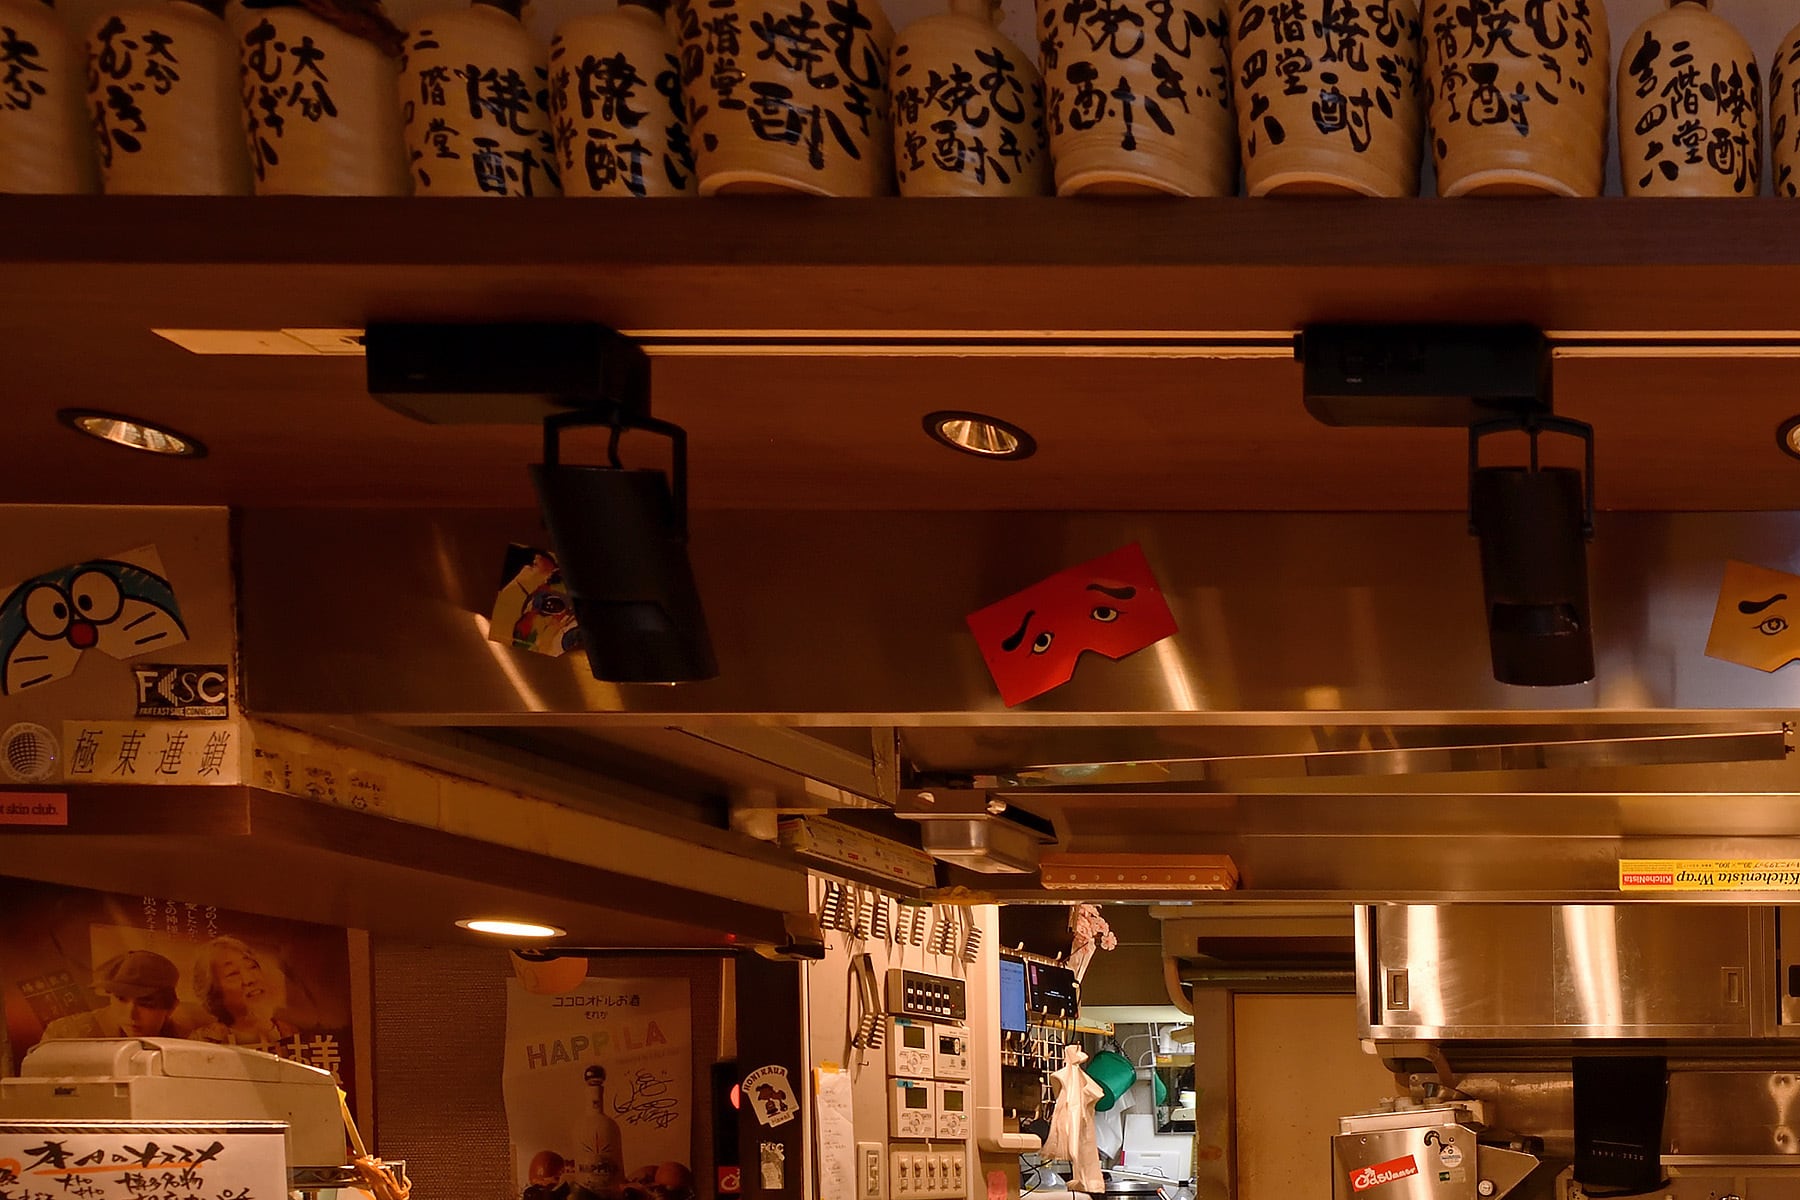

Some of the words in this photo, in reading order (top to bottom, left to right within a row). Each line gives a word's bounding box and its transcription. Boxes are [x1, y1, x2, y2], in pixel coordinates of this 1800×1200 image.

[71, 728, 231, 778] 極東連鎖
[1676, 870, 1714, 885] Wrap
[1718, 872, 1800, 885] Kitchenista
[526, 1020, 667, 1070] HAPPILA
